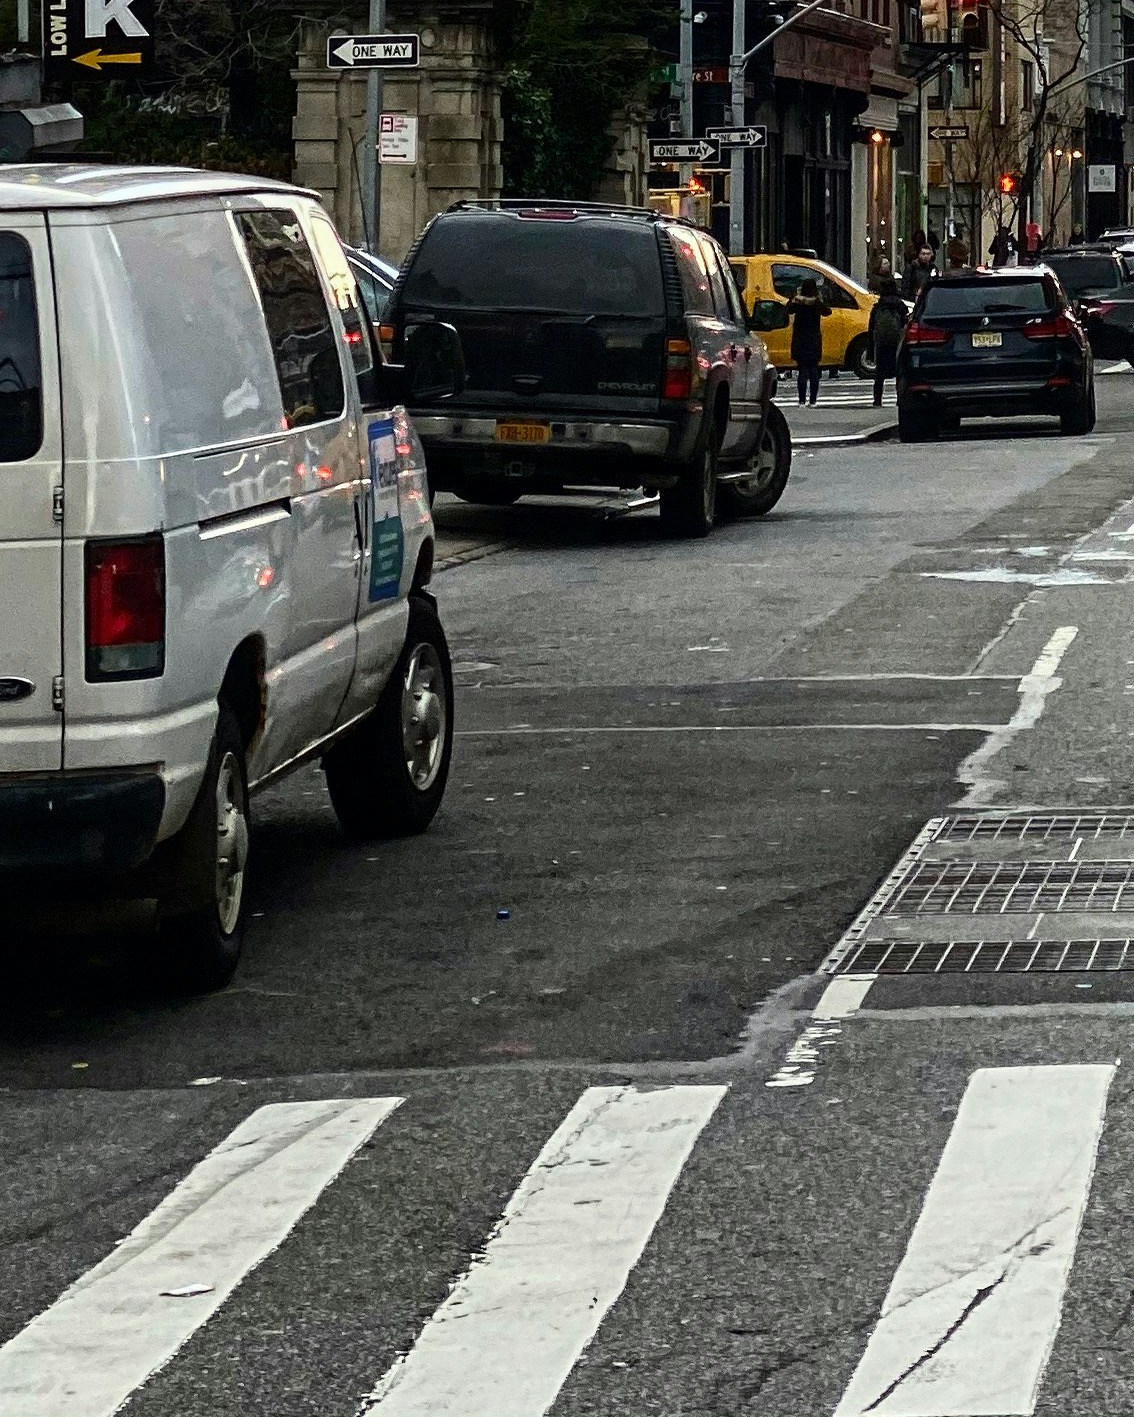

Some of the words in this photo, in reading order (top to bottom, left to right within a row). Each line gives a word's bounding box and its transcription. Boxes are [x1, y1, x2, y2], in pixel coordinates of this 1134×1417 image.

[50, 14, 68, 56] LOW
[352, 45, 377, 58] ONE
[382, 44, 409, 57] WAY
[739, 132, 757, 142] WAY
[657, 145, 679, 157] ONE
[687, 145, 709, 157] WAY
